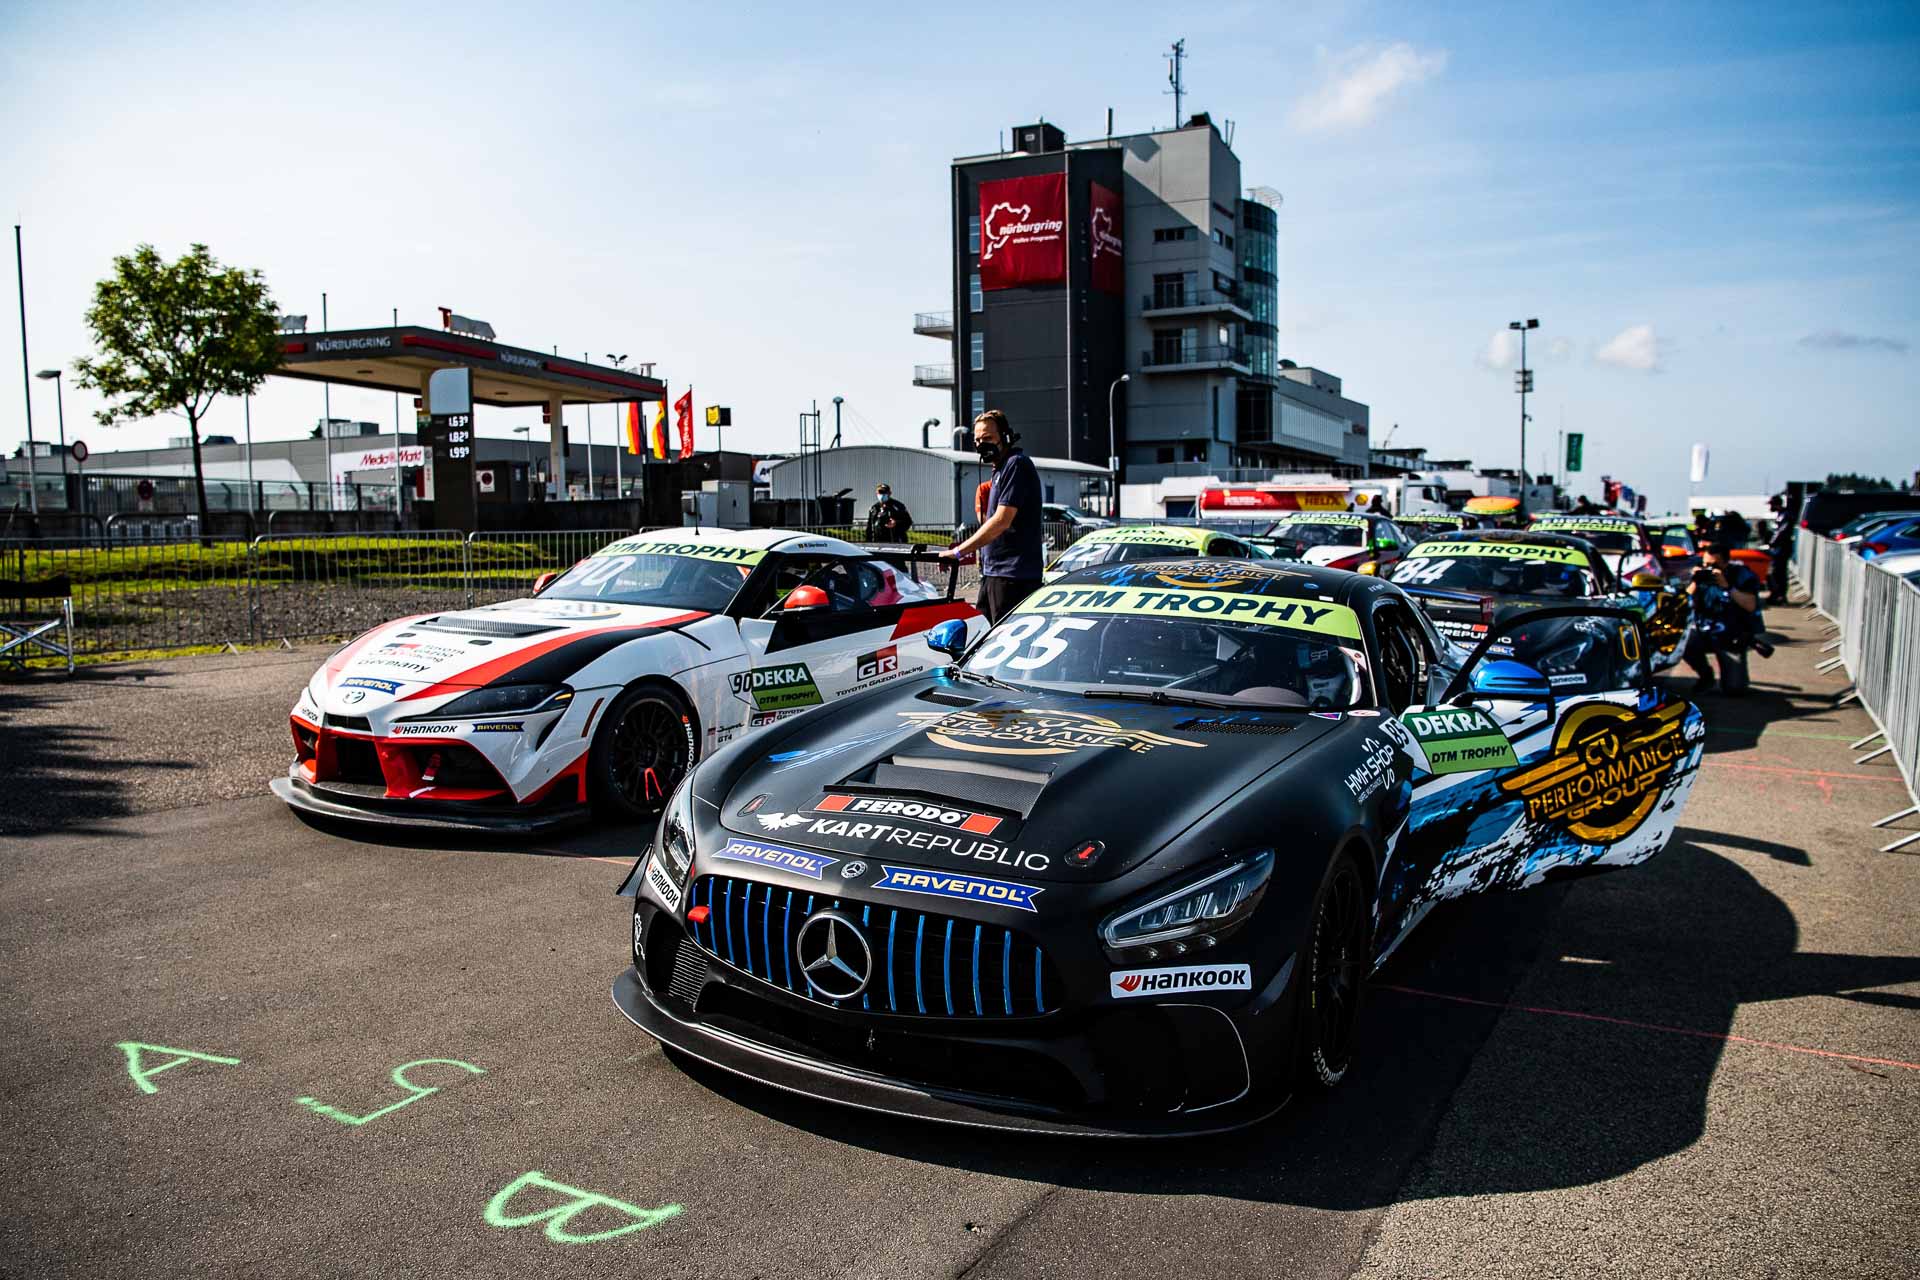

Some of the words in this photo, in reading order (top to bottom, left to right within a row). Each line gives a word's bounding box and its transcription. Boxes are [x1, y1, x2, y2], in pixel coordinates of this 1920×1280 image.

[999, 220, 1063, 236] nürburgring
[315, 336, 391, 352] NÜRBURGRING
[651, 543, 758, 561] TROPHY
[1122, 536, 1196, 547] TROPHY
[1421, 544, 1470, 555] DTM
[1477, 545, 1573, 560] TROPHY
[1389, 558, 1456, 584] 84
[1033, 591, 1128, 609] DTM
[1131, 592, 1334, 626] TROPHY
[968, 616, 1098, 671] 85
[733, 673, 752, 694] 90
[752, 666, 809, 688] DEKRA
[836, 683, 867, 696] TOYOTA
[898, 665, 923, 676] Racing
[760, 695, 779, 704] DTM
[780, 691, 816, 701] TROPHY
[1412, 712, 1494, 736] DEKRA
[717, 733, 733, 743] GT4
[1432, 751, 1457, 763] DTM
[1461, 745, 1508, 760] TROPHY
[1344, 763, 1373, 796] HMH
[1366, 744, 1395, 777] SHOP
[1529, 733, 1685, 820] PERFORMANCE
[1567, 773, 1657, 820] GROUP
[852, 800, 968, 825] FERODO
[807, 818, 1050, 871] KARTREPUBLIC
